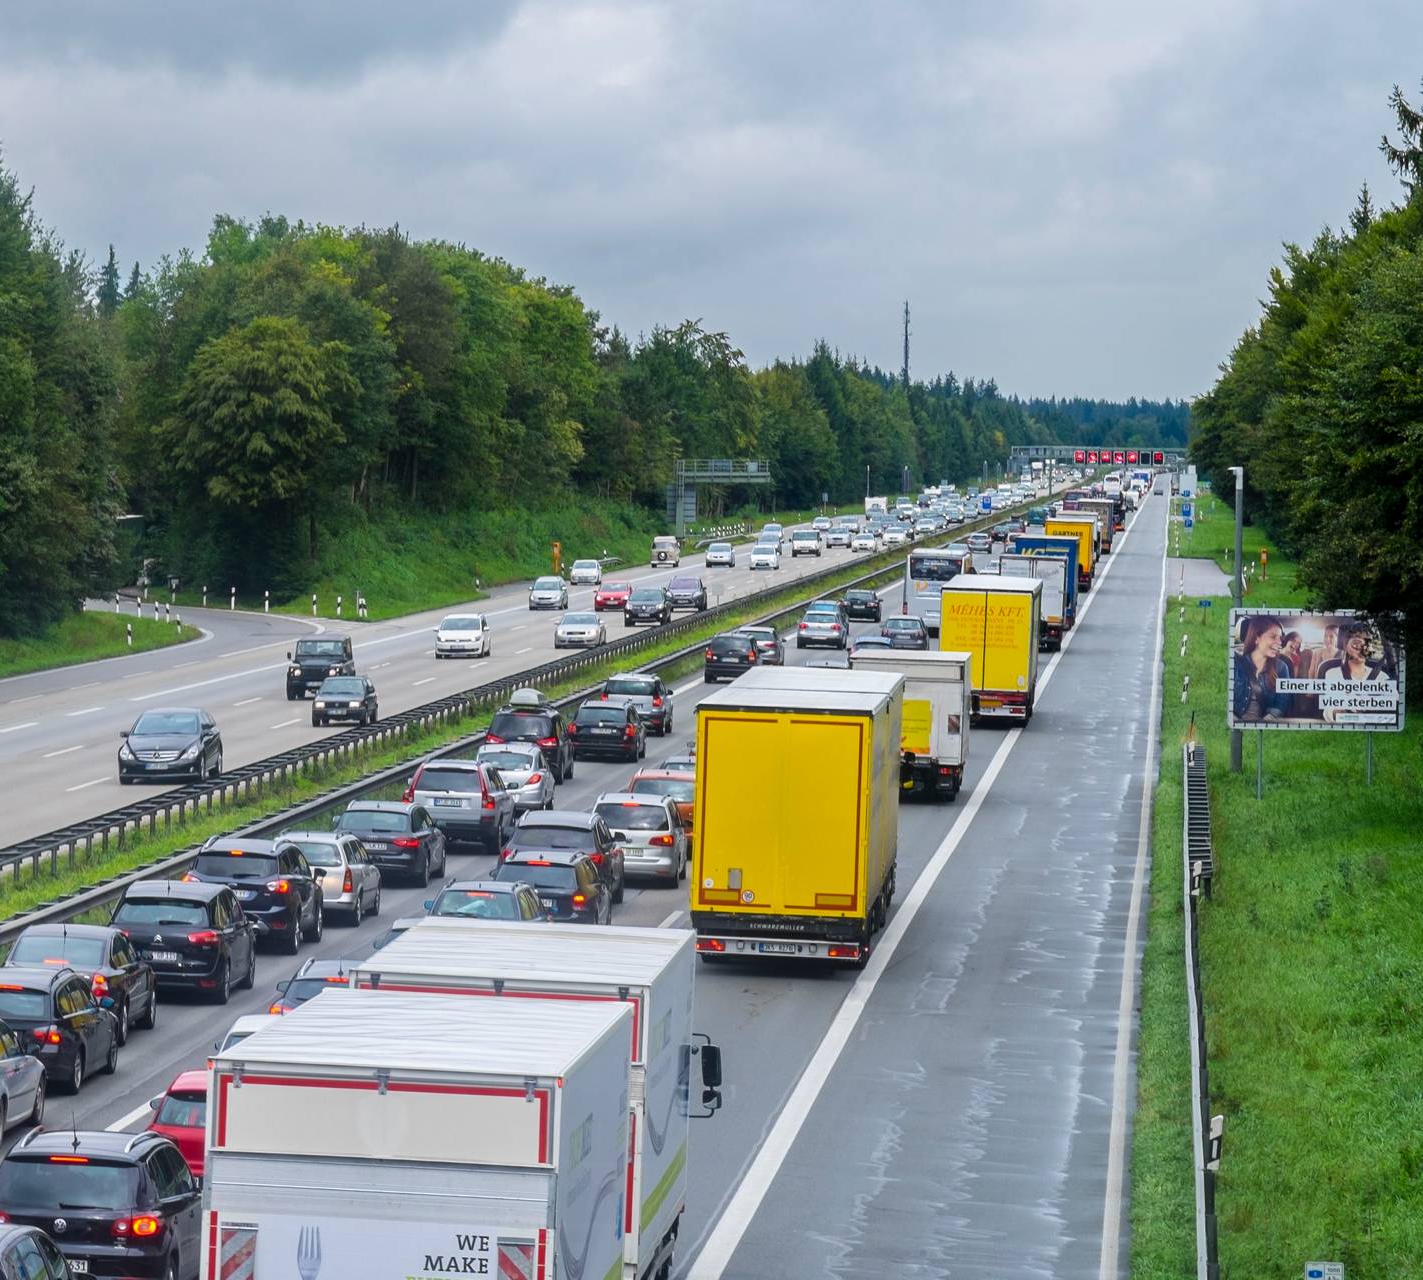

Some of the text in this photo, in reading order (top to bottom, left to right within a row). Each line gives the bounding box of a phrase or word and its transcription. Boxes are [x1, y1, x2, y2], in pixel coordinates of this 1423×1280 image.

[1280, 680, 1393, 694] Einer ist abgelenkt,
[1322, 696, 1393, 708] vier sterben
[456, 1234, 490, 1251] WE
[423, 1255, 489, 1274] MAKE
